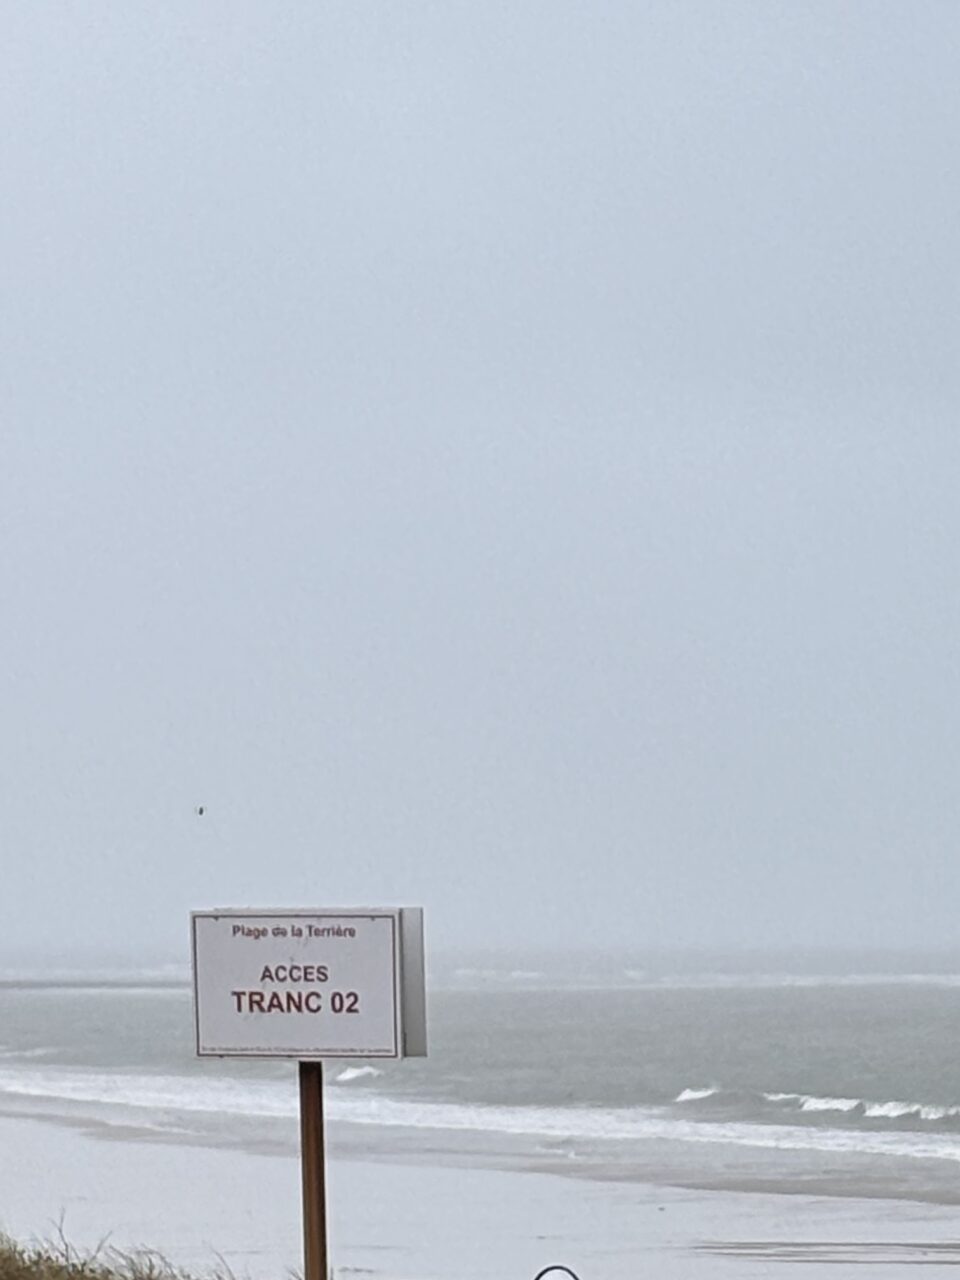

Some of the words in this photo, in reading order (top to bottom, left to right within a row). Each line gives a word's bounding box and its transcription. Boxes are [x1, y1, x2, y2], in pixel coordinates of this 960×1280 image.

[232, 924, 268, 940] Plage
[271, 924, 288, 937] de
[291, 924, 303, 937] la
[260, 965, 329, 982] ACCES
[231, 991, 322, 1014] TRANC
[330, 991, 360, 1014] 02
